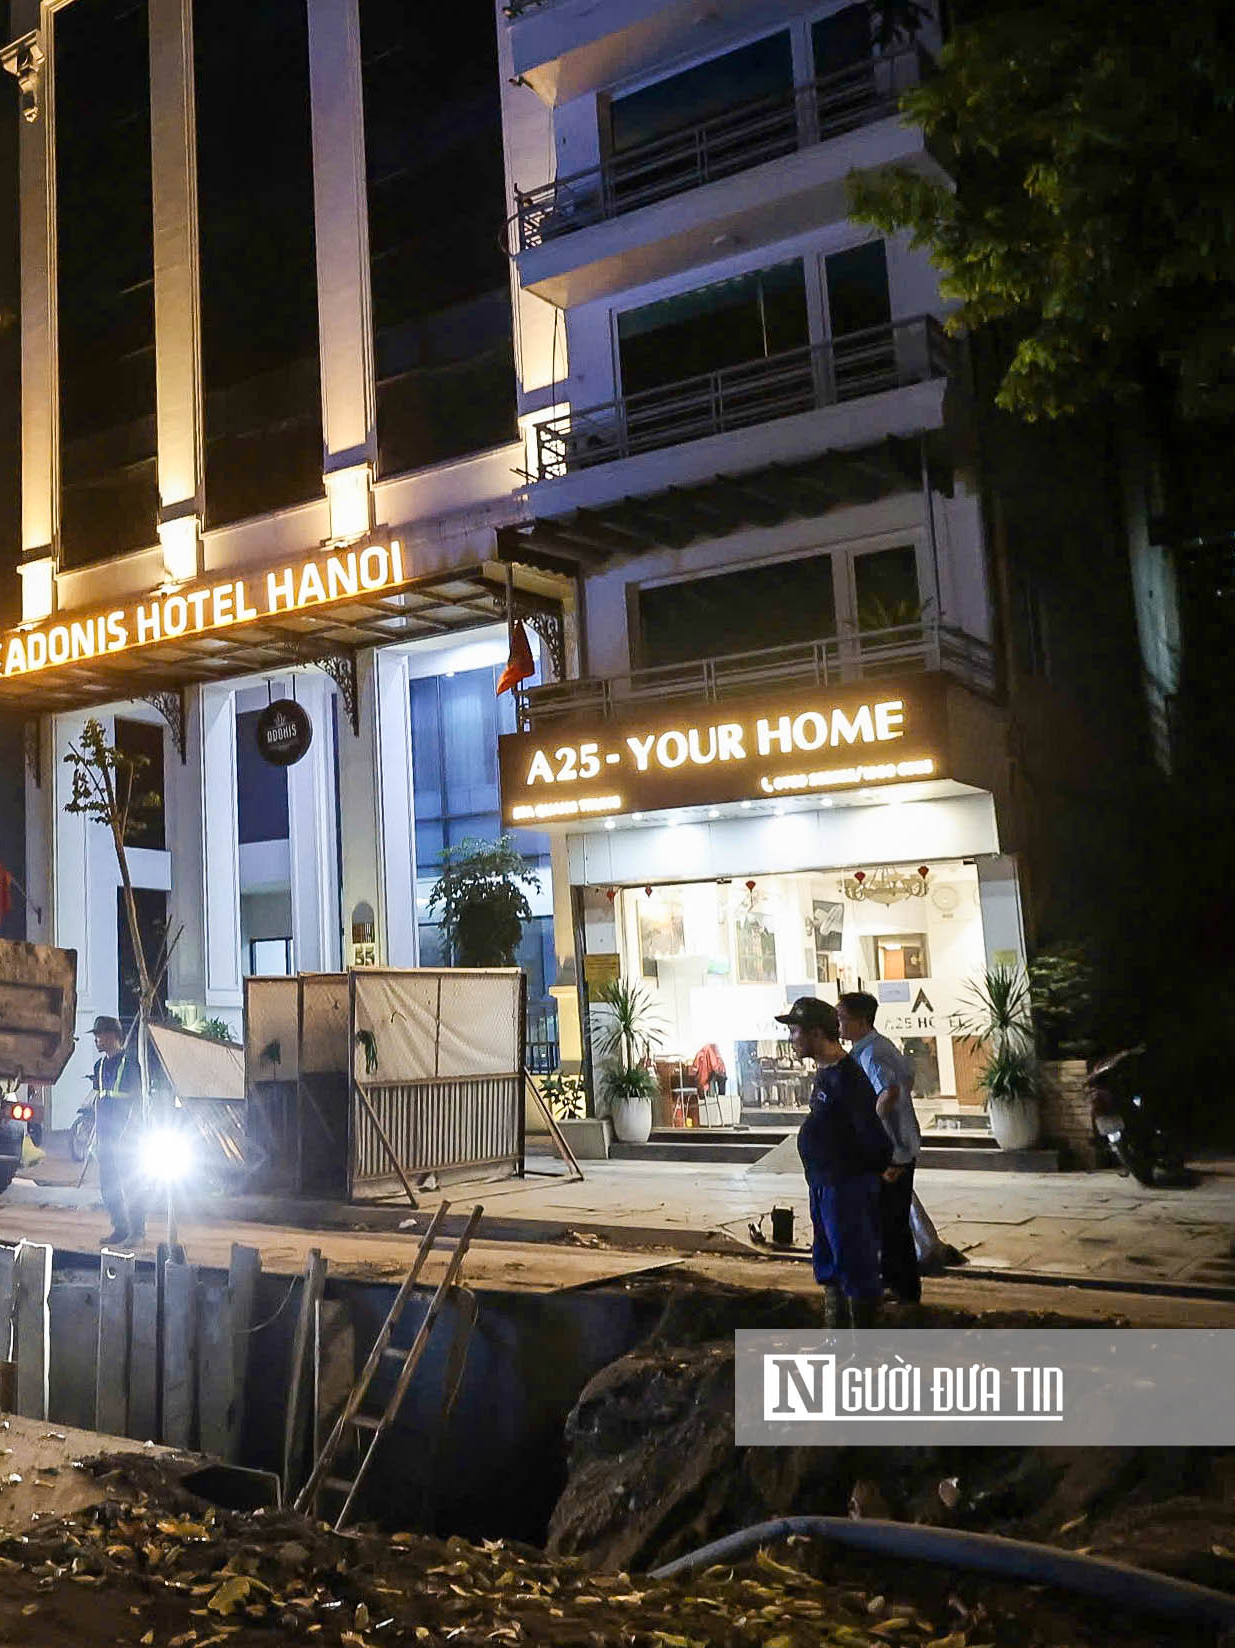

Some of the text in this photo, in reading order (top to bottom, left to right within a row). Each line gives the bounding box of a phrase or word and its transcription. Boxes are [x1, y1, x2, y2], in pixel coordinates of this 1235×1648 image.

[5, 540, 404, 675] ADONIS HOTEL HANOI
[267, 723, 298, 744] ADONIS
[626, 723, 747, 771] YOUR
[756, 700, 905, 756] HOME
[917, 1015, 965, 1029] HOEL
